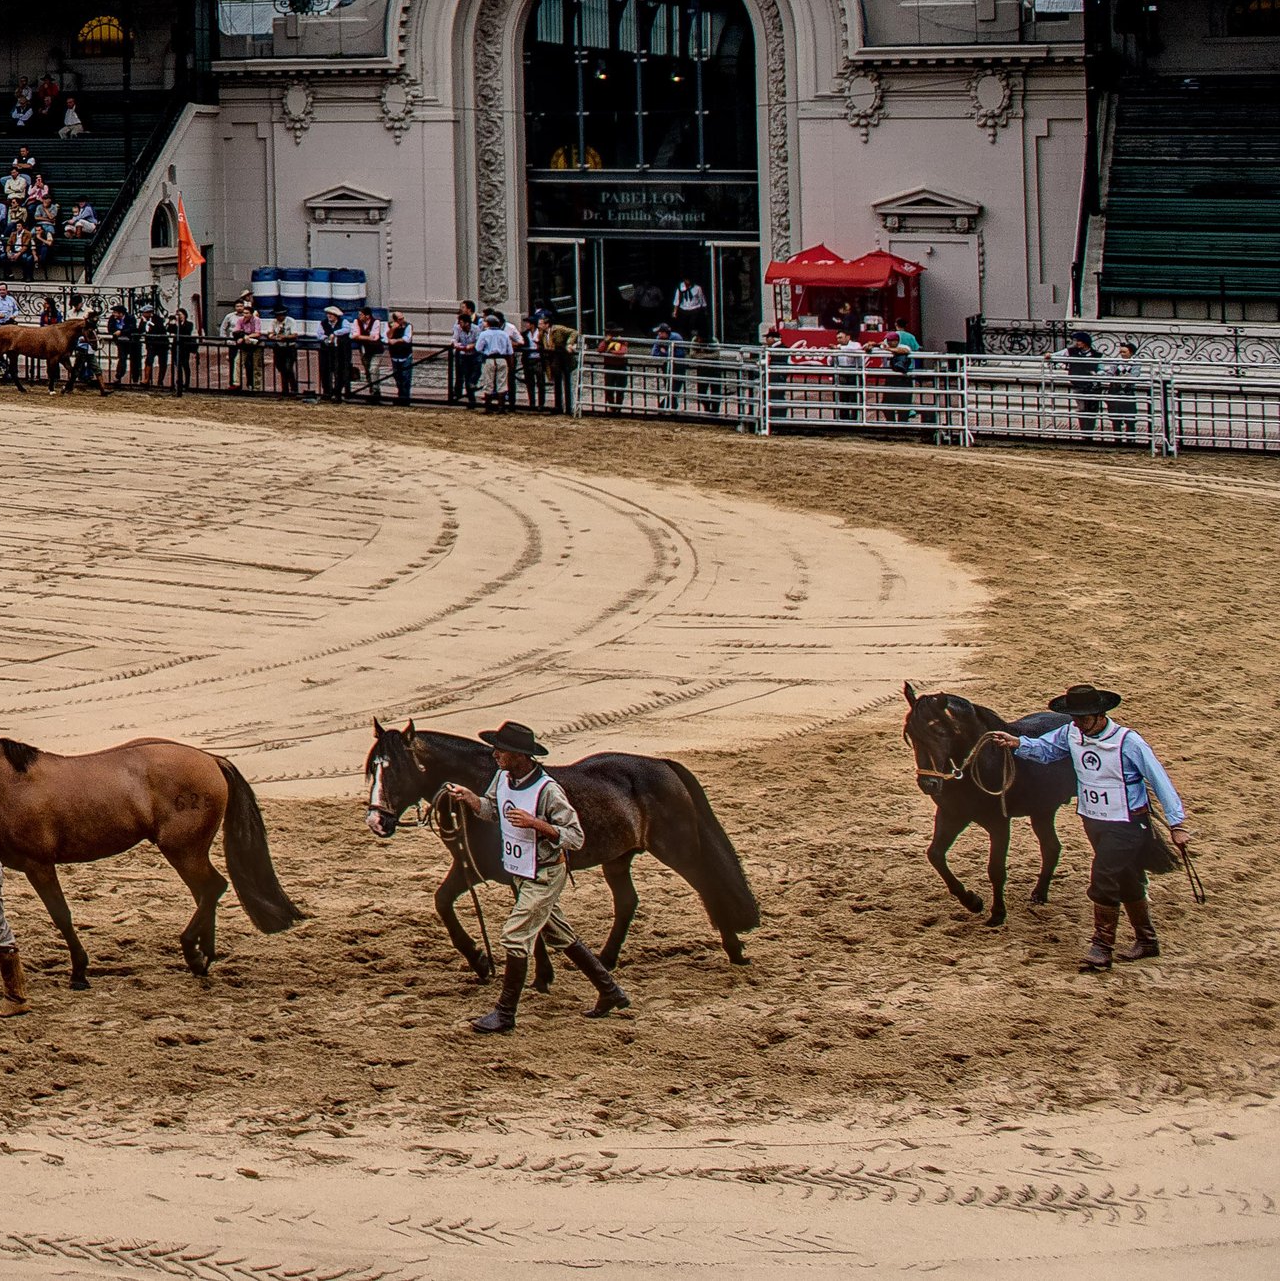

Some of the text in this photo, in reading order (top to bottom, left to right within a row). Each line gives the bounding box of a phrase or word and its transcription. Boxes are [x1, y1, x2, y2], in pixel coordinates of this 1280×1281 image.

[601, 191, 686, 204] PABELLON
[583, 209, 603, 221] Dr.
[1083, 788, 1109, 805] 191
